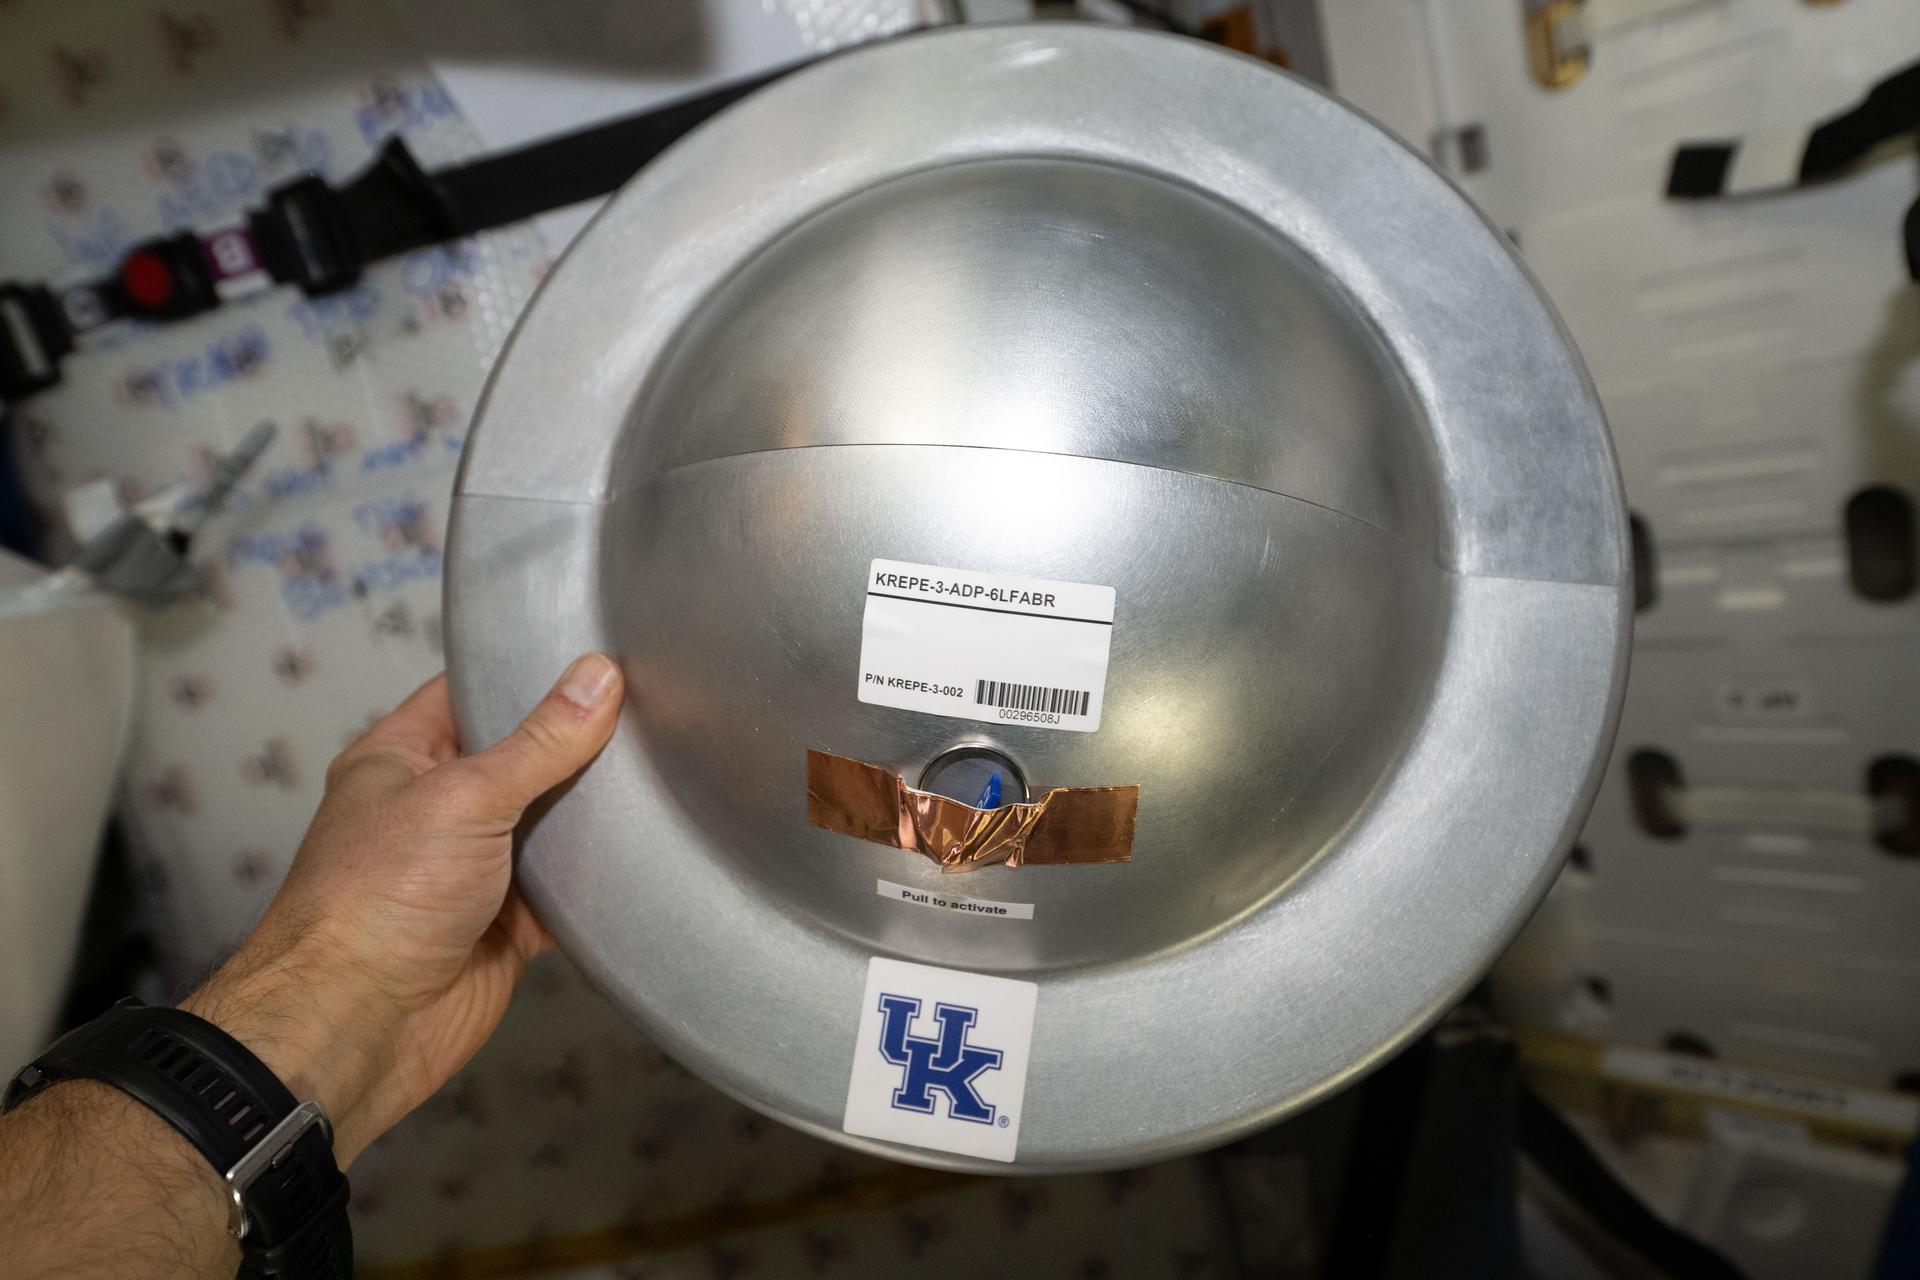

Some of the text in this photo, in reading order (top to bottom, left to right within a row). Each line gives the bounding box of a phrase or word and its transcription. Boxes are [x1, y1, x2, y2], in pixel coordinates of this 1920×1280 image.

[875, 572, 1056, 607] KREPE-3-ADP-6LFABR
[865, 673, 964, 698] P/N KREPE-3-002
[998, 708, 1061, 725] 00296508J
[902, 890, 1008, 915] Pull to activate
[877, 992, 1004, 1126] UK
